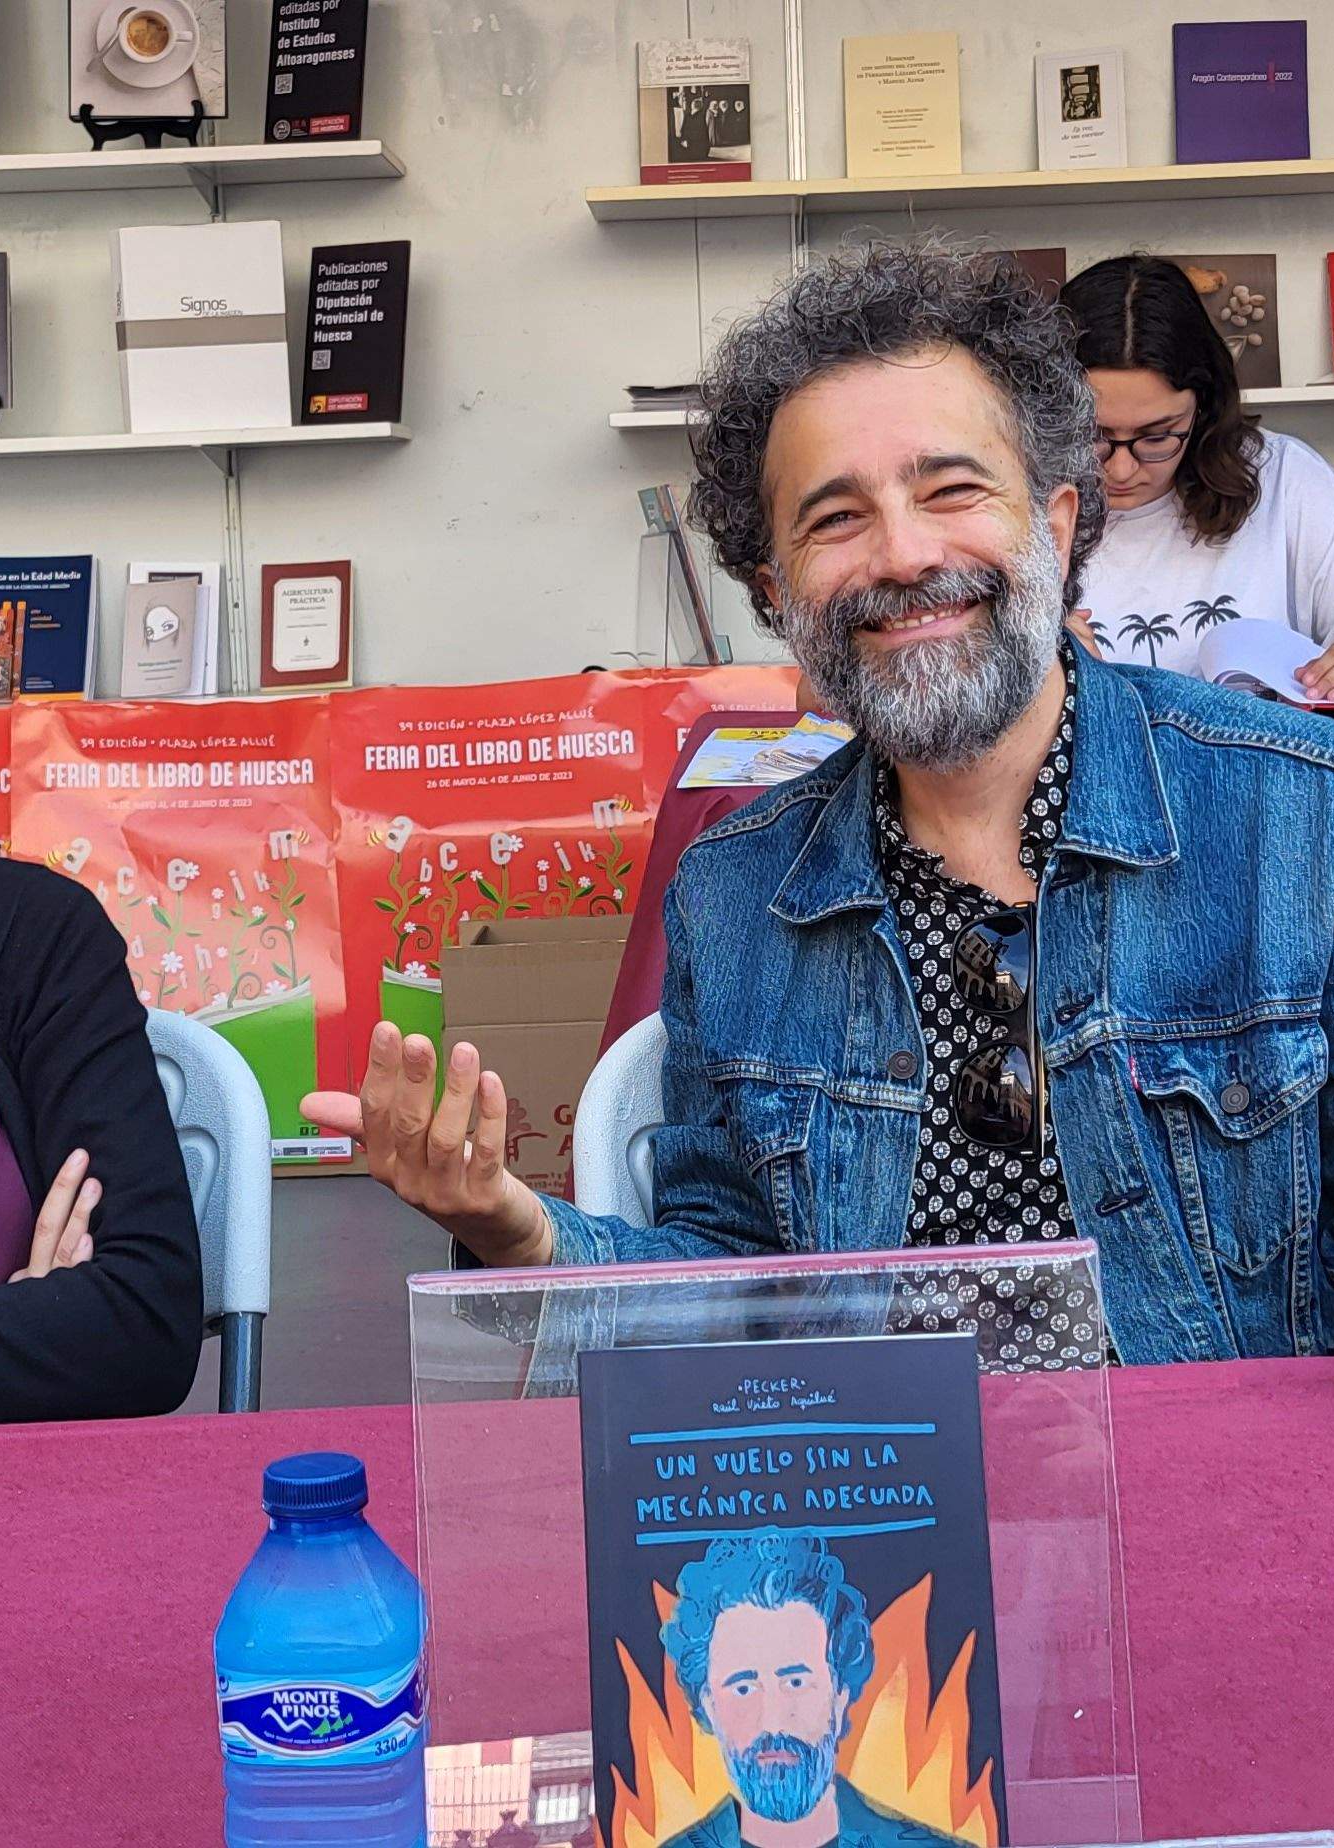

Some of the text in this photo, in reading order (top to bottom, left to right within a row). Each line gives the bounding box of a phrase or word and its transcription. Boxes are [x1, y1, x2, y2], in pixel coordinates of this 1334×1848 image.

[280, 0, 340, 16] editadas por
[279, 17, 320, 33] Instituto
[277, 32, 336, 49] de Estudios
[276, 48, 355, 67] Altoaragoneses
[1274, 72, 1293, 80] 2022
[318, 260, 388, 276] Publicaciones
[317, 278, 380, 293] editadas por
[180, 296, 228, 316] Signos
[316, 294, 373, 311] Diputación
[315, 309, 384, 326] Provincial de
[314, 330, 353, 343] Huesca
[8, 573, 20, 581] en
[21, 572, 29, 581] la
[31, 571, 53, 581] Edad
[55, 570, 81, 580] Media
[282, 588, 333, 597] AGRICULTURA
[399, 706, 595, 732] 39 EDICIÓN PLAZA LÓPEZ ALLUÉ
[80, 734, 276, 749] 39 EDICIÓN PLAZA LÓPEZ ALLUÉ
[365, 729, 636, 771] FERIA DEL LIBRO DE HUESCA
[45, 758, 314, 788] FERIA DEL LIBRO DE HUESCA
[426, 771, 573, 789] 26 DE MAYO AL 4 DE JUNIO DE 2023
[157, 800, 169, 809] AL
[178, 800, 190, 809] DE
[219, 799, 230, 808] DE
[232, 798, 253, 808] 2023
[655, 1444, 898, 1480] UN VUELO SIN LA
[636, 1483, 935, 1523] MECÁNICA ADECUADA
[273, 1691, 340, 1705] MONTE
[282, 1704, 340, 1718] PINOS
[374, 1737, 398, 1756] 330
